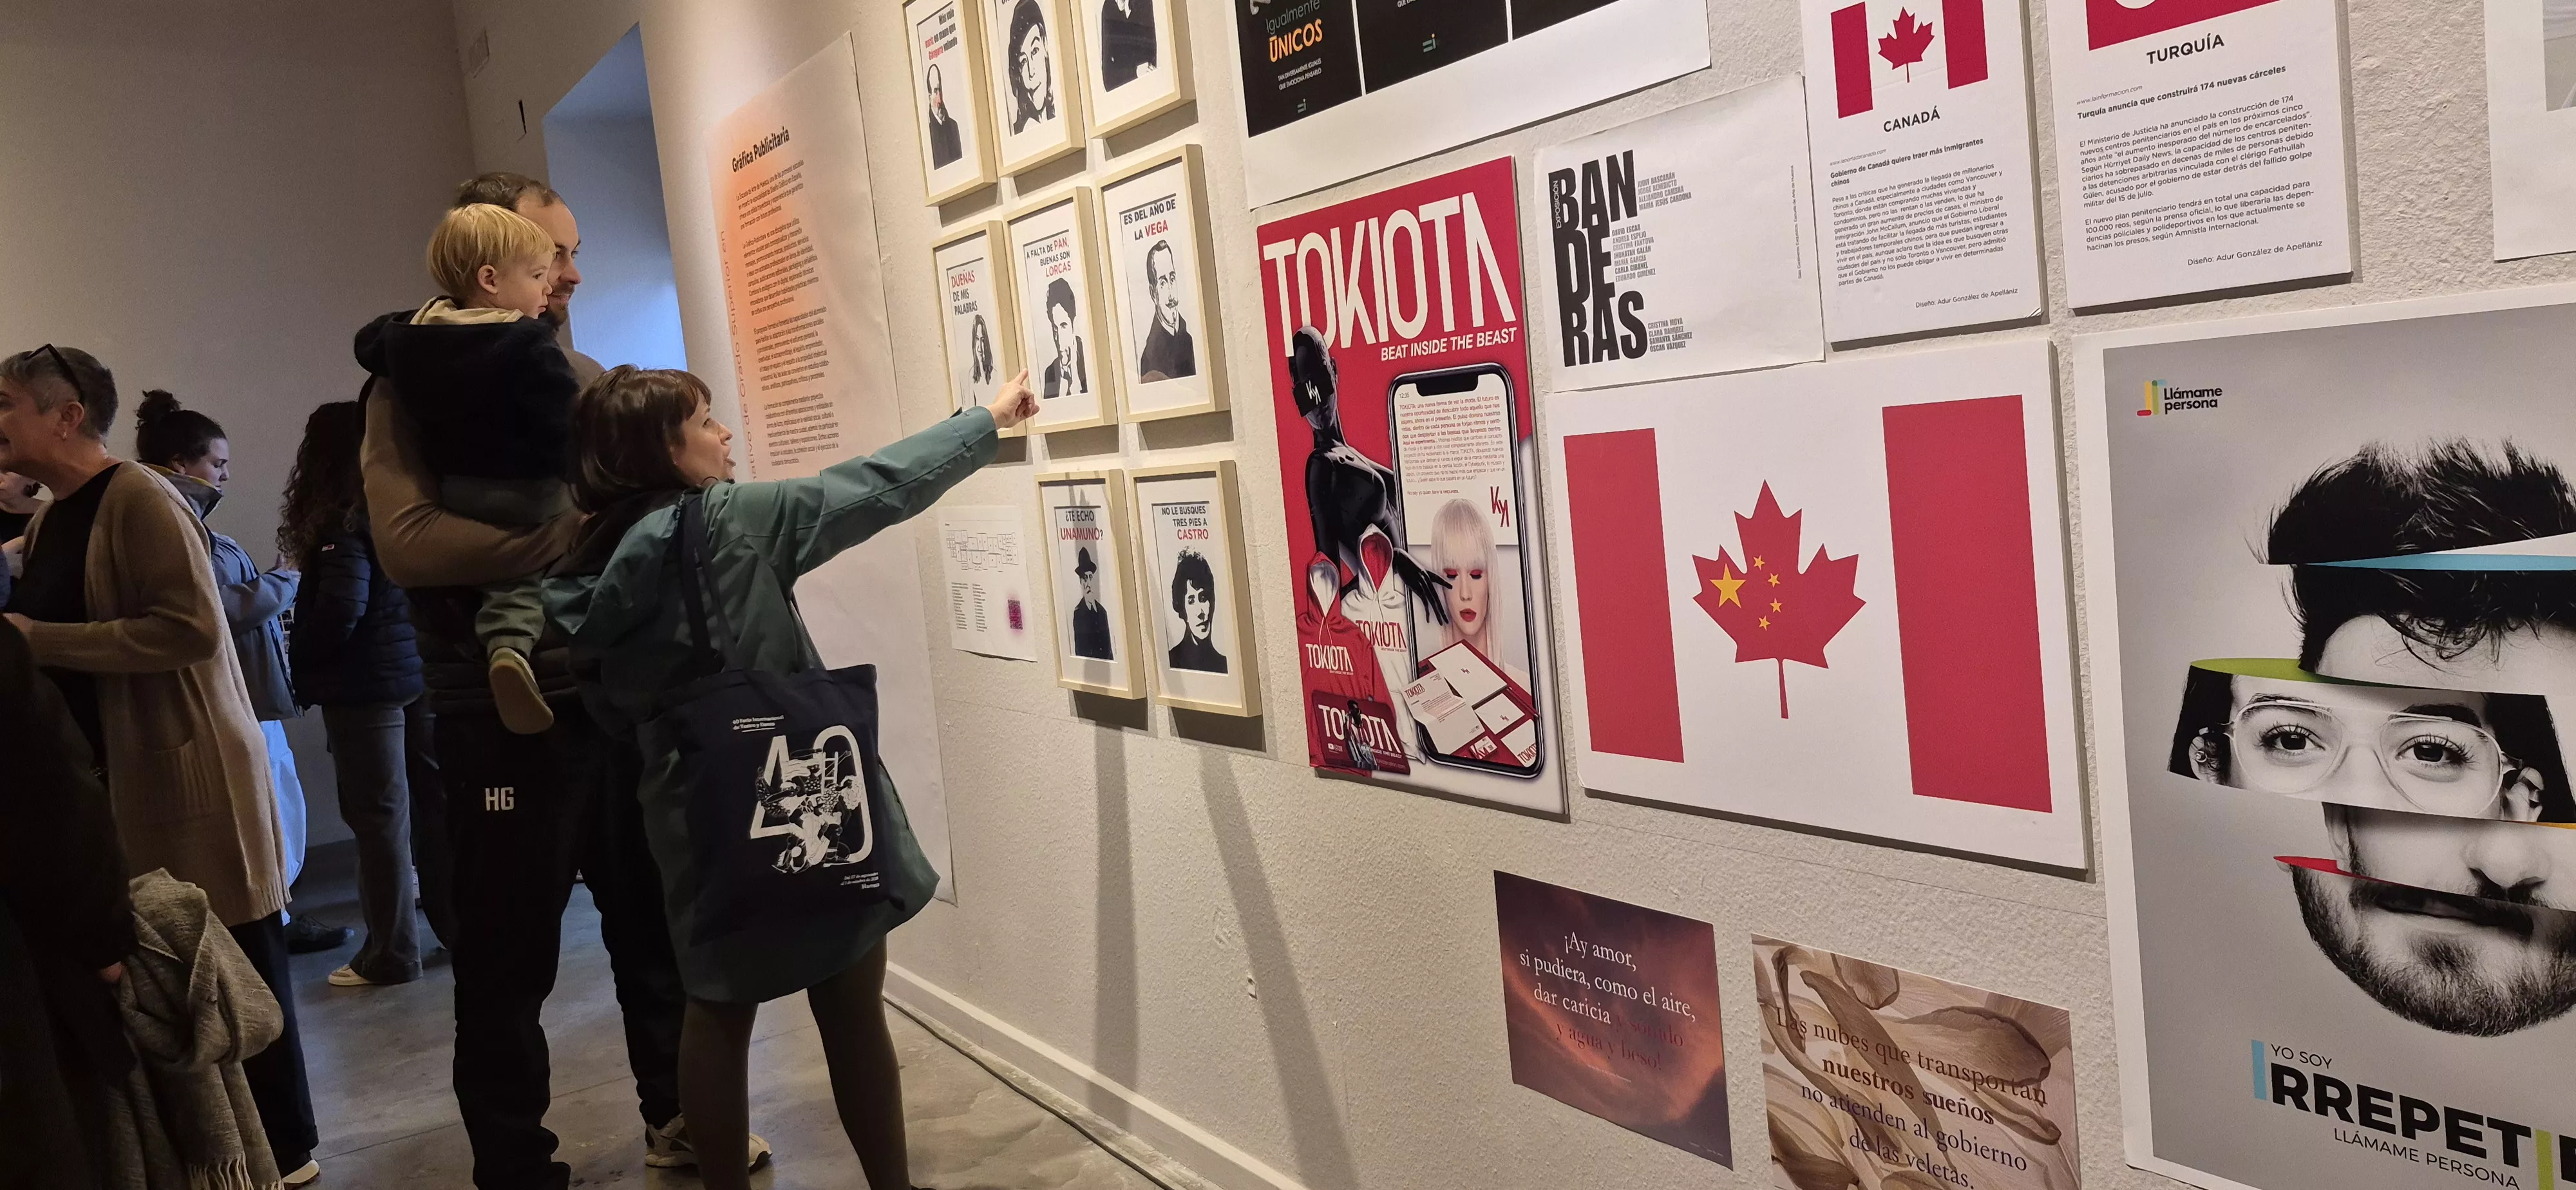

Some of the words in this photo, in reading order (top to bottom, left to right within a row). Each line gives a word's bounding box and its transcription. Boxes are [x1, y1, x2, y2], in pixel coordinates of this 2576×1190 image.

[1266, 0, 1320, 35] Igualmente
[2146, 33, 2224, 64] TURQUÍA
[2077, 107, 2106, 118] Turquía
[2140, 97, 2155, 105] que
[2200, 81, 2214, 90] 174
[2217, 75, 2247, 87] nuevas
[2249, 66, 2286, 79] cárceles
[1883, 105, 1940, 132] CANADÁ
[2080, 147, 2104, 156] nuevos
[2105, 141, 2130, 150] centros
[2132, 130, 2181, 146] penitenciarios
[2202, 121, 2217, 131] país
[2243, 109, 2279, 122] próximos
[2282, 104, 2302, 113] cinco
[2087, 134, 2119, 145] Ministerio
[2132, 126, 2158, 136] Justicia
[2170, 115, 2208, 128] anunciado
[2218, 102, 2267, 117] construcción
[2281, 95, 2293, 103] 174
[732, 151, 753, 173] Gráfica
[753, 126, 790, 160] Publicitaria
[1830, 168, 1857, 178] Gobierno
[1868, 159, 1889, 169] Canadá
[1891, 155, 1911, 165] quiere
[1929, 147, 1942, 155] más
[1944, 138, 1983, 152] inmigrantes
[1831, 178, 1849, 187] chinos
[1124, 214, 1133, 225] ES
[1135, 209, 1148, 222] DEL
[1150, 202, 1164, 218] AÑO
[1166, 198, 1176, 211] DE
[1553, 180, 1561, 229] EXPOSICIÓN
[1135, 229, 1143, 240] LA
[1144, 220, 1168, 237] VEGA
[1031, 247, 1046, 258] FALTA
[1046, 245, 1053, 253] DE
[1040, 256, 1059, 266] BUENAS
[1060, 250, 1070, 260] SON
[2188, 257, 2213, 265] Diseño:
[2237, 249, 2271, 258] González
[2286, 240, 2322, 250] Apellániz
[951, 269, 975, 288] DUEÑAS
[1045, 261, 1072, 278] LORCAS
[724, 259, 738, 336] Superior
[953, 291, 960, 302] DE
[960, 288, 969, 299] MIS
[954, 301, 978, 316] PALABRAS
[1381, 345, 1408, 361] BEAT
[1410, 337, 1447, 357] INSIDE
[1450, 334, 1473, 351] THE
[1476, 328, 1517, 346] BEAST
[2164, 387, 2223, 401] Llámame
[2164, 399, 2218, 415] persona
[1066, 511, 1075, 522] ¿TE
[1076, 510, 1094, 522] ECHO
[1162, 507, 1170, 515] NO
[1180, 506, 1206, 515] BUSQUES
[1173, 518, 1187, 527] TRES
[1189, 518, 1202, 526] PIES
[1061, 528, 1103, 540] UNAMUNO?
[1177, 529, 1208, 540] CASTRO
[485, 787, 514, 811] HG
[1564, 931, 1587, 959] ¡Ay
[1592, 944, 1636, 972] amor,
[1520, 949, 1531, 967] si
[1534, 958, 1591, 990] pudiera,
[1595, 976, 1638, 1000] como
[1643, 987, 1657, 1006] el
[1662, 992, 1696, 1023] aire,
[1534, 983, 1558, 1005] dar
[1562, 998, 1611, 1024] caricia
[1556, 1023, 1562, 1041] y
[1569, 1028, 1603, 1050] agua
[1607, 1042, 1615, 1060] y
[1622, 1040, 1662, 1070] beso!
[1776, 1006, 1807, 1034] Las
[1814, 1024, 1869, 1052] nubes
[1875, 1042, 1911, 1064] que
[1918, 1051, 2048, 1104] transportan
[2271, 1043, 2294, 1059] YO
[2299, 1051, 2332, 1069] SOY
[1821, 1057, 1915, 1100] nuestros
[1923, 1091, 1994, 1125] sueños
[1801, 1085, 1823, 1103] no
[1830, 1092, 1906, 1131] atienden
[1913, 1117, 1928, 1139] al
[1937, 1129, 2027, 1171] gobierno
[1850, 1128, 1870, 1152] de
[1877, 1136, 1899, 1163] las
[1905, 1153, 1975, 1190] veletas.
[2334, 1128, 2420, 1162] LLÁMAME
[2427, 1153, 2520, 1189] PERSONA
